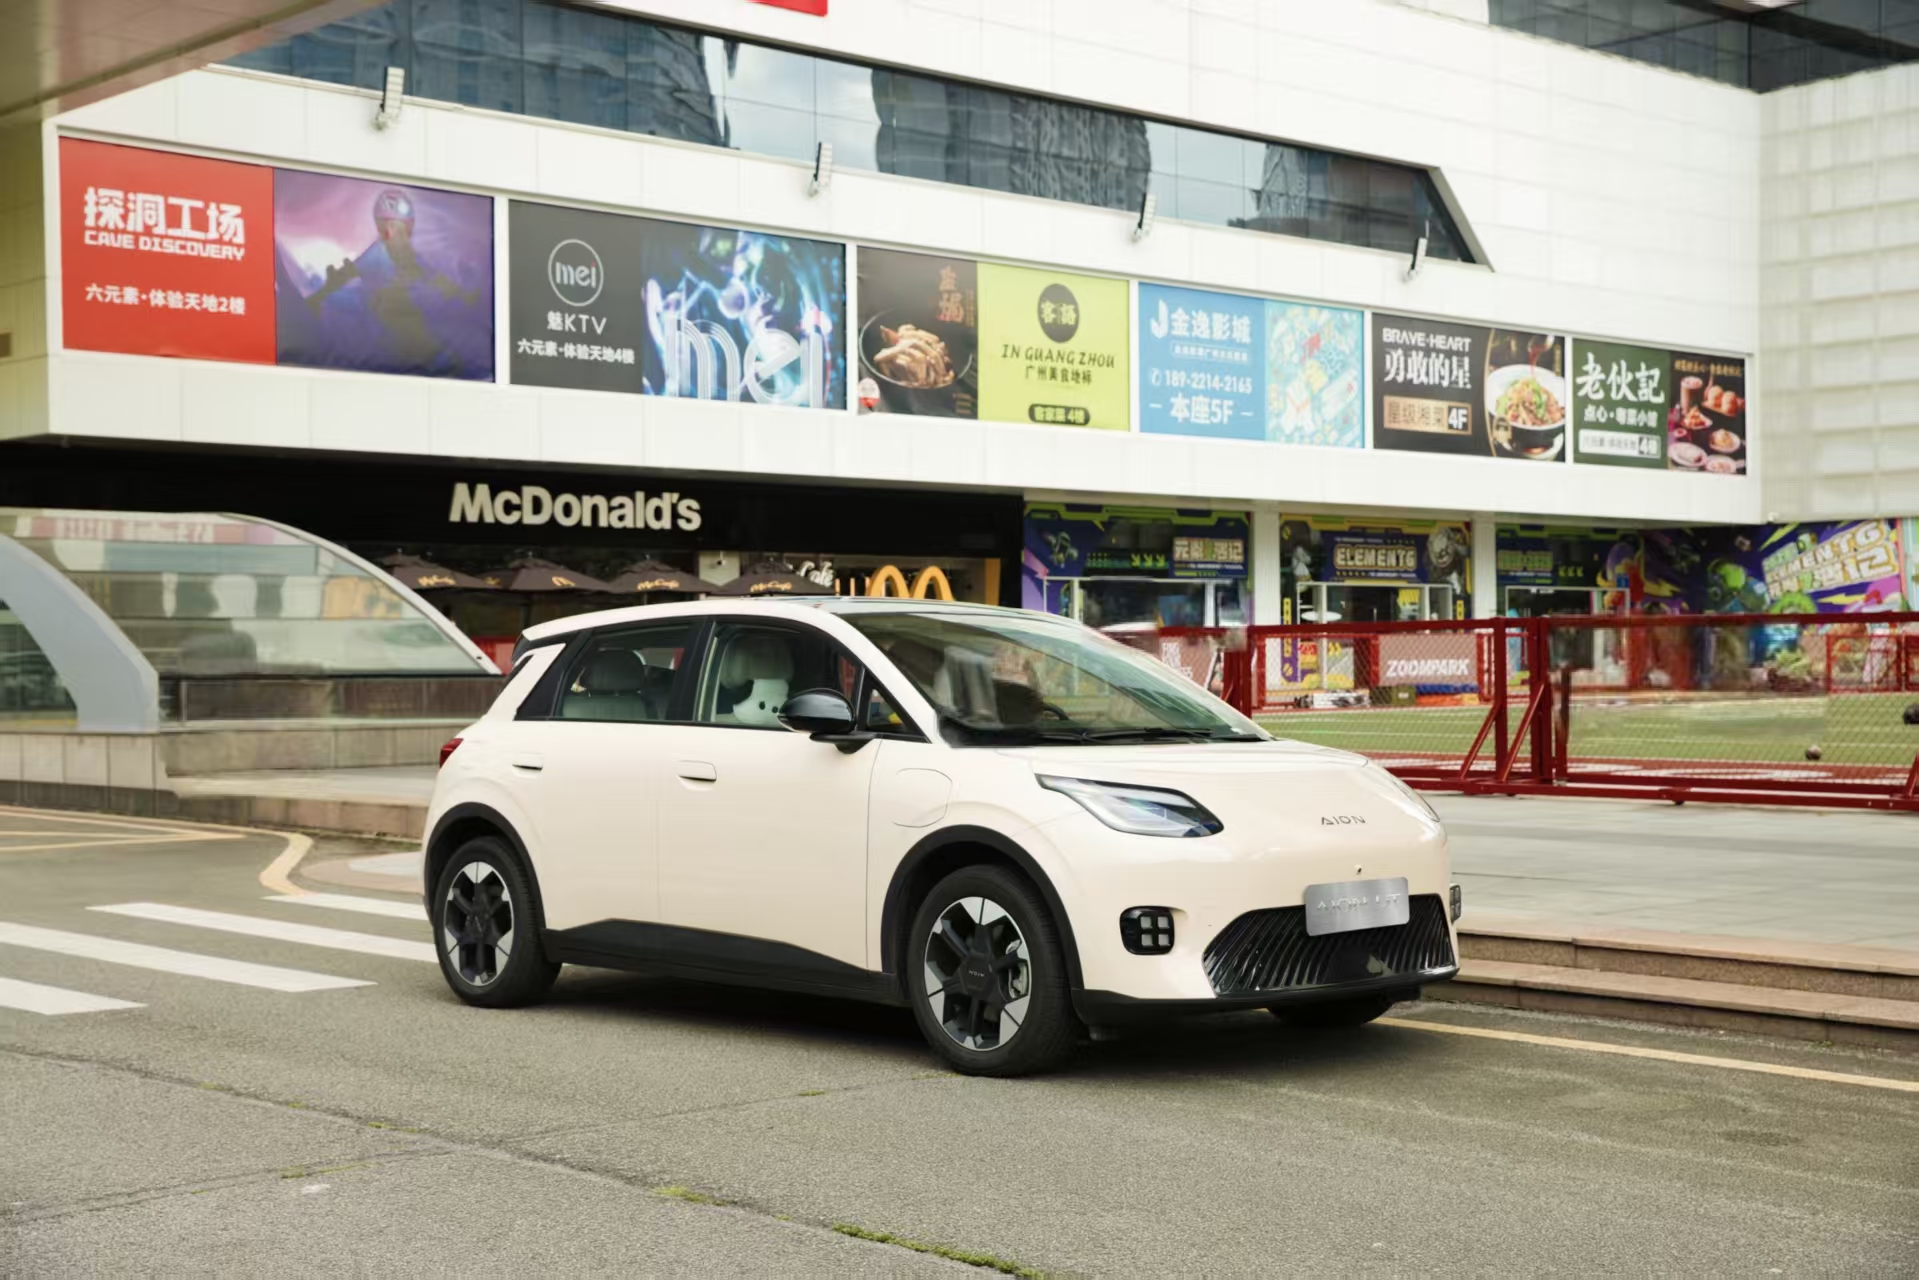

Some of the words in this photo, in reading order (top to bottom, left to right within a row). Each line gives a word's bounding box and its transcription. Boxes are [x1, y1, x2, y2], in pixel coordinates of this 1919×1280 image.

[84, 186, 246, 245] 探洞工场
[84, 229, 135, 250] CAVE
[138, 235, 246, 262] DISCOVERY
[555, 260, 597, 288] mei
[1001, 343, 1021, 360] IN
[1169, 392, 1235, 425] 本座5F
[1447, 407, 1468, 431] 4F
[449, 482, 702, 532] McDonald's
[1386, 658, 1472, 679] ZOOMPARK
[1321, 815, 1366, 825] AION
